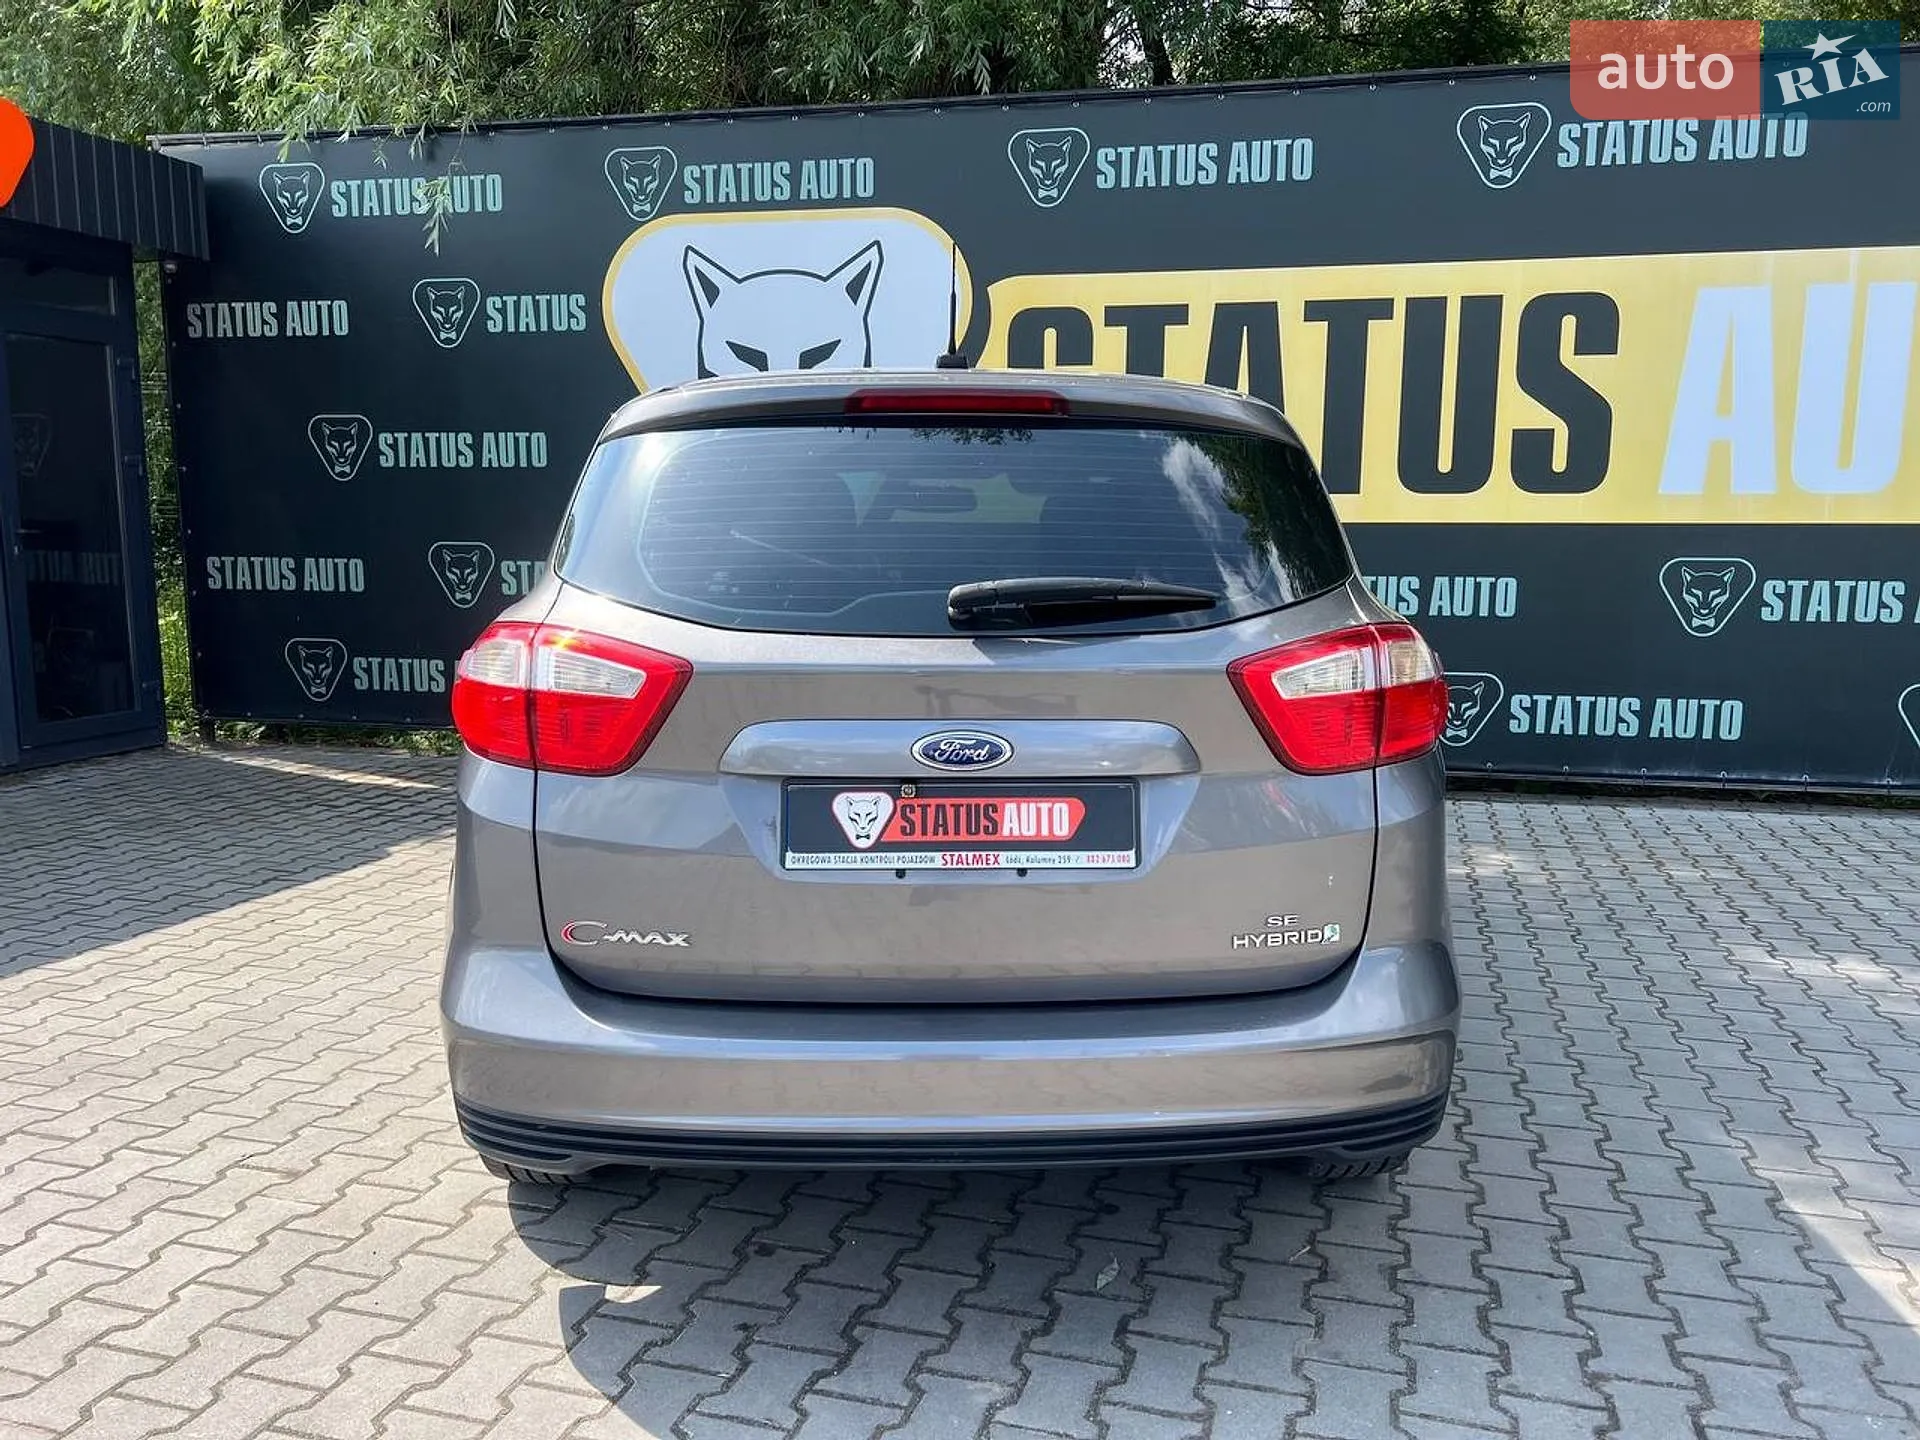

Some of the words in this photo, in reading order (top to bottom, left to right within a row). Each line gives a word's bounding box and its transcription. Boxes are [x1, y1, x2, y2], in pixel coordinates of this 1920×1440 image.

[1557, 117, 1699, 168] STATUS
[1708, 111, 1809, 161] AUTO
[684, 160, 791, 204] STATUS
[799, 157, 875, 200] AUTO
[1096, 142, 1218, 190] STATUS
[1228, 138, 1313, 184] AUTO
[331, 177, 429, 218] STATUS
[437, 174, 503, 213] AUTO
[186, 301, 278, 339] STATUS
[286, 300, 349, 337] AUTO
[486, 294, 586, 333] STATUS
[1658, 281, 1918, 495] AU
[379, 432, 474, 469] STATUS
[481, 432, 548, 468] AUTO
[207, 556, 296, 592] STATUS
[304, 557, 365, 593] AUTO
[1428, 576, 1518, 617] AUTO
[1761, 579, 1906, 623] STATUS
[353, 657, 446, 693] STATUS
[1508, 694, 1640, 738] STATUS
[1649, 697, 1744, 742] AUTO
[934, 739, 989, 761] Ford
[900, 803, 999, 837] STATUS
[1002, 802, 1070, 837] AUTO
[941, 853, 1000, 867] STALMEX
[1232, 929, 1322, 950] HYBRID
[1267, 914, 1298, 928] SE
